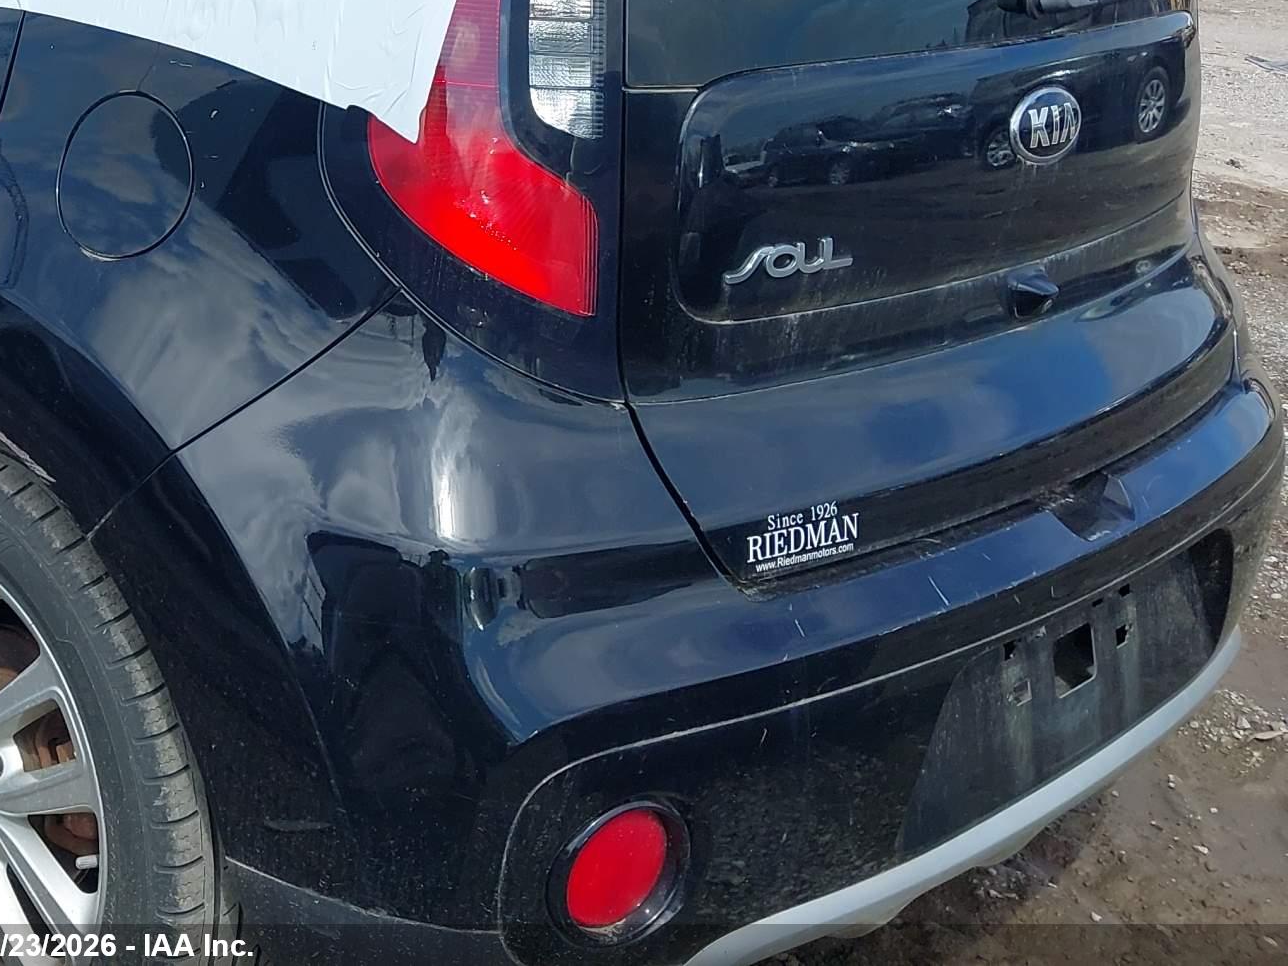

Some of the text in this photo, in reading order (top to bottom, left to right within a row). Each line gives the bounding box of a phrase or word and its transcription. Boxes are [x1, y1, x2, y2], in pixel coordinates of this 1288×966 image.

[1027, 101, 1078, 149] KIA
[767, 501, 838, 531] Since 1926
[746, 512, 859, 563] RIEDMAN
[755, 543, 854, 573] www.Riedmanmotors.com
